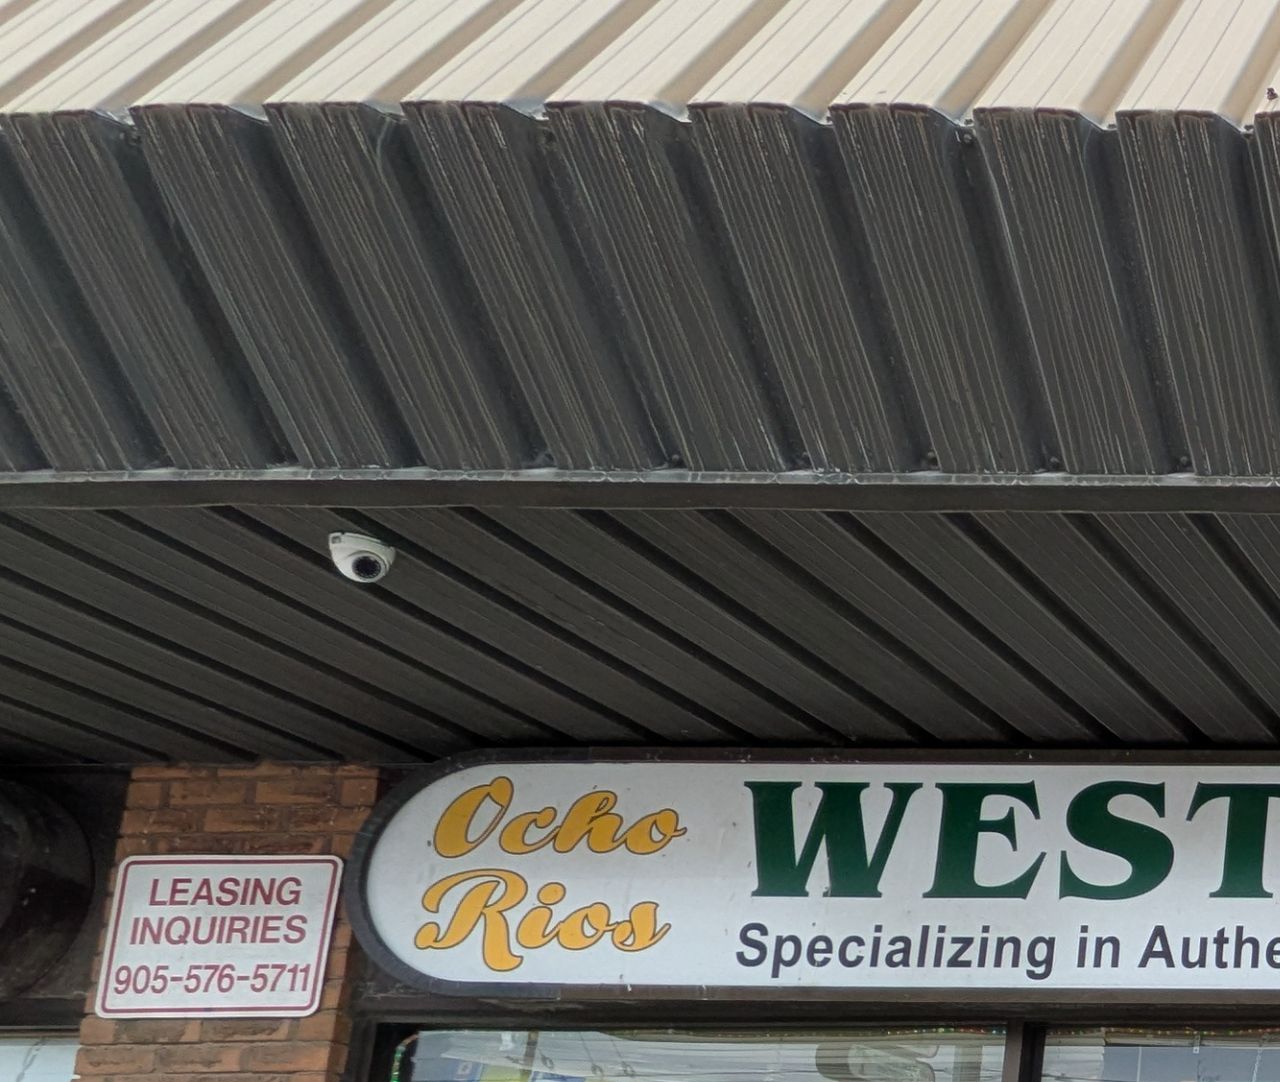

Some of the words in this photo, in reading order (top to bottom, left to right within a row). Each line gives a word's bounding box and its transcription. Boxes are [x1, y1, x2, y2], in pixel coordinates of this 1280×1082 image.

[433, 775, 687, 859] Ocho
[148, 876, 303, 907] LEASING
[129, 915, 308, 946] INQUIRIES
[414, 867, 671, 972] Rios
[735, 922, 1056, 980] Specializing
[1076, 924, 1120, 969] in
[113, 962, 312, 995] 905-576-5711
